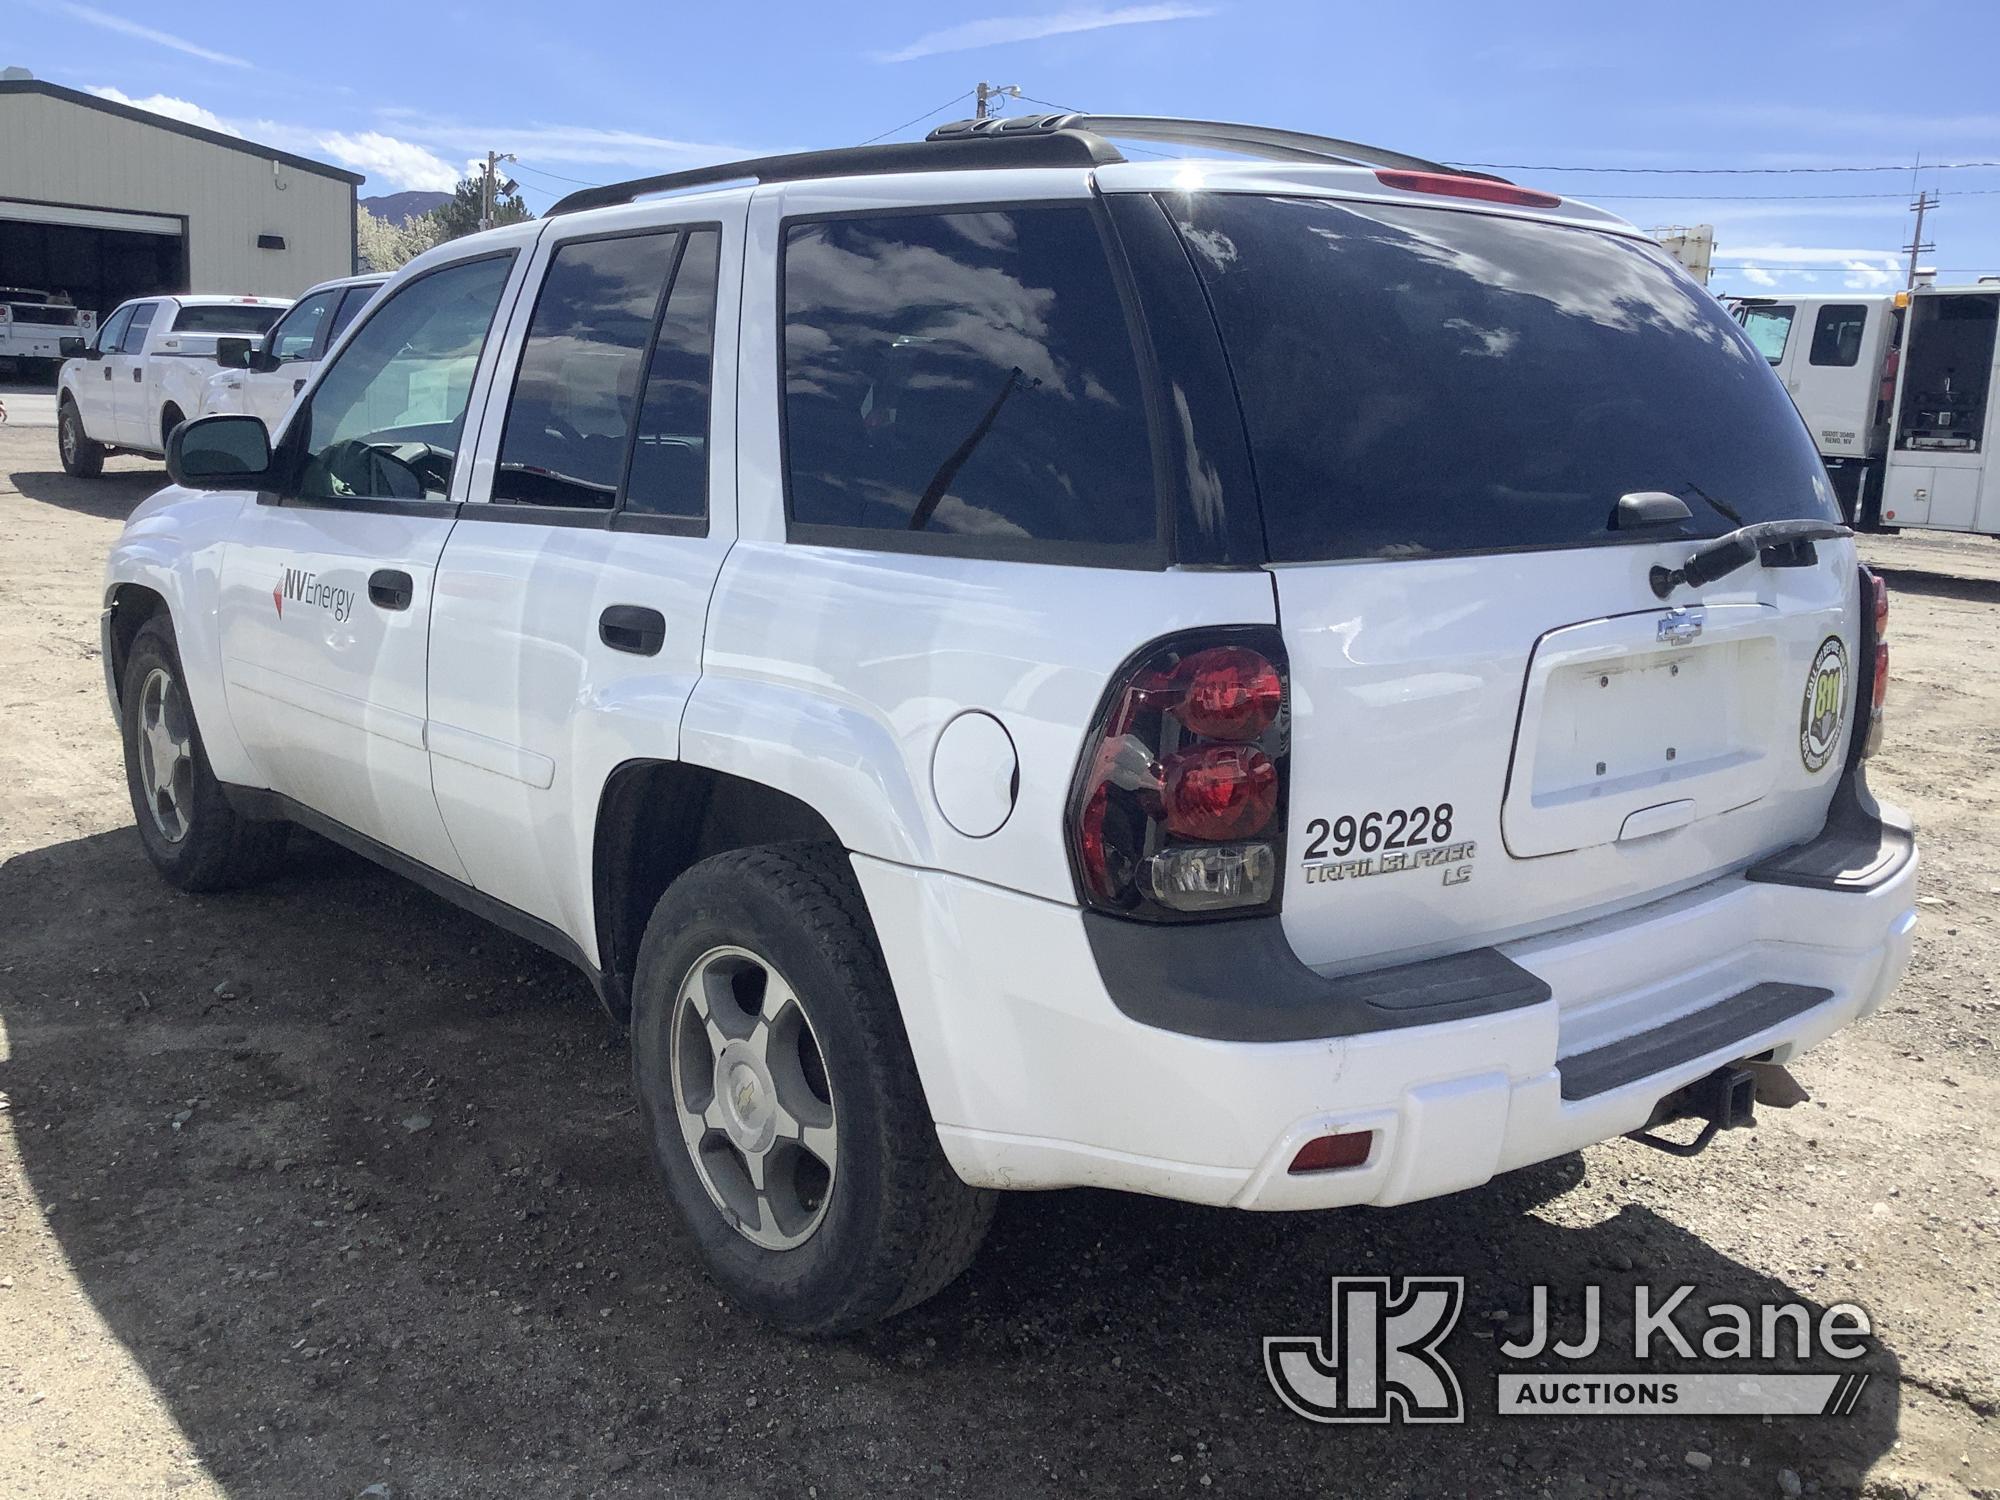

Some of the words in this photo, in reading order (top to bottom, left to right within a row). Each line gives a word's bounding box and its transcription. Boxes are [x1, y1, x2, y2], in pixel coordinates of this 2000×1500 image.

[1806, 669, 1818, 698] CALL
[1815, 667, 1840, 719] 811
[1304, 803, 1453, 860] 296228
[1302, 841, 1477, 884] TRAILBLAZER
[1442, 865, 1473, 886] LS
